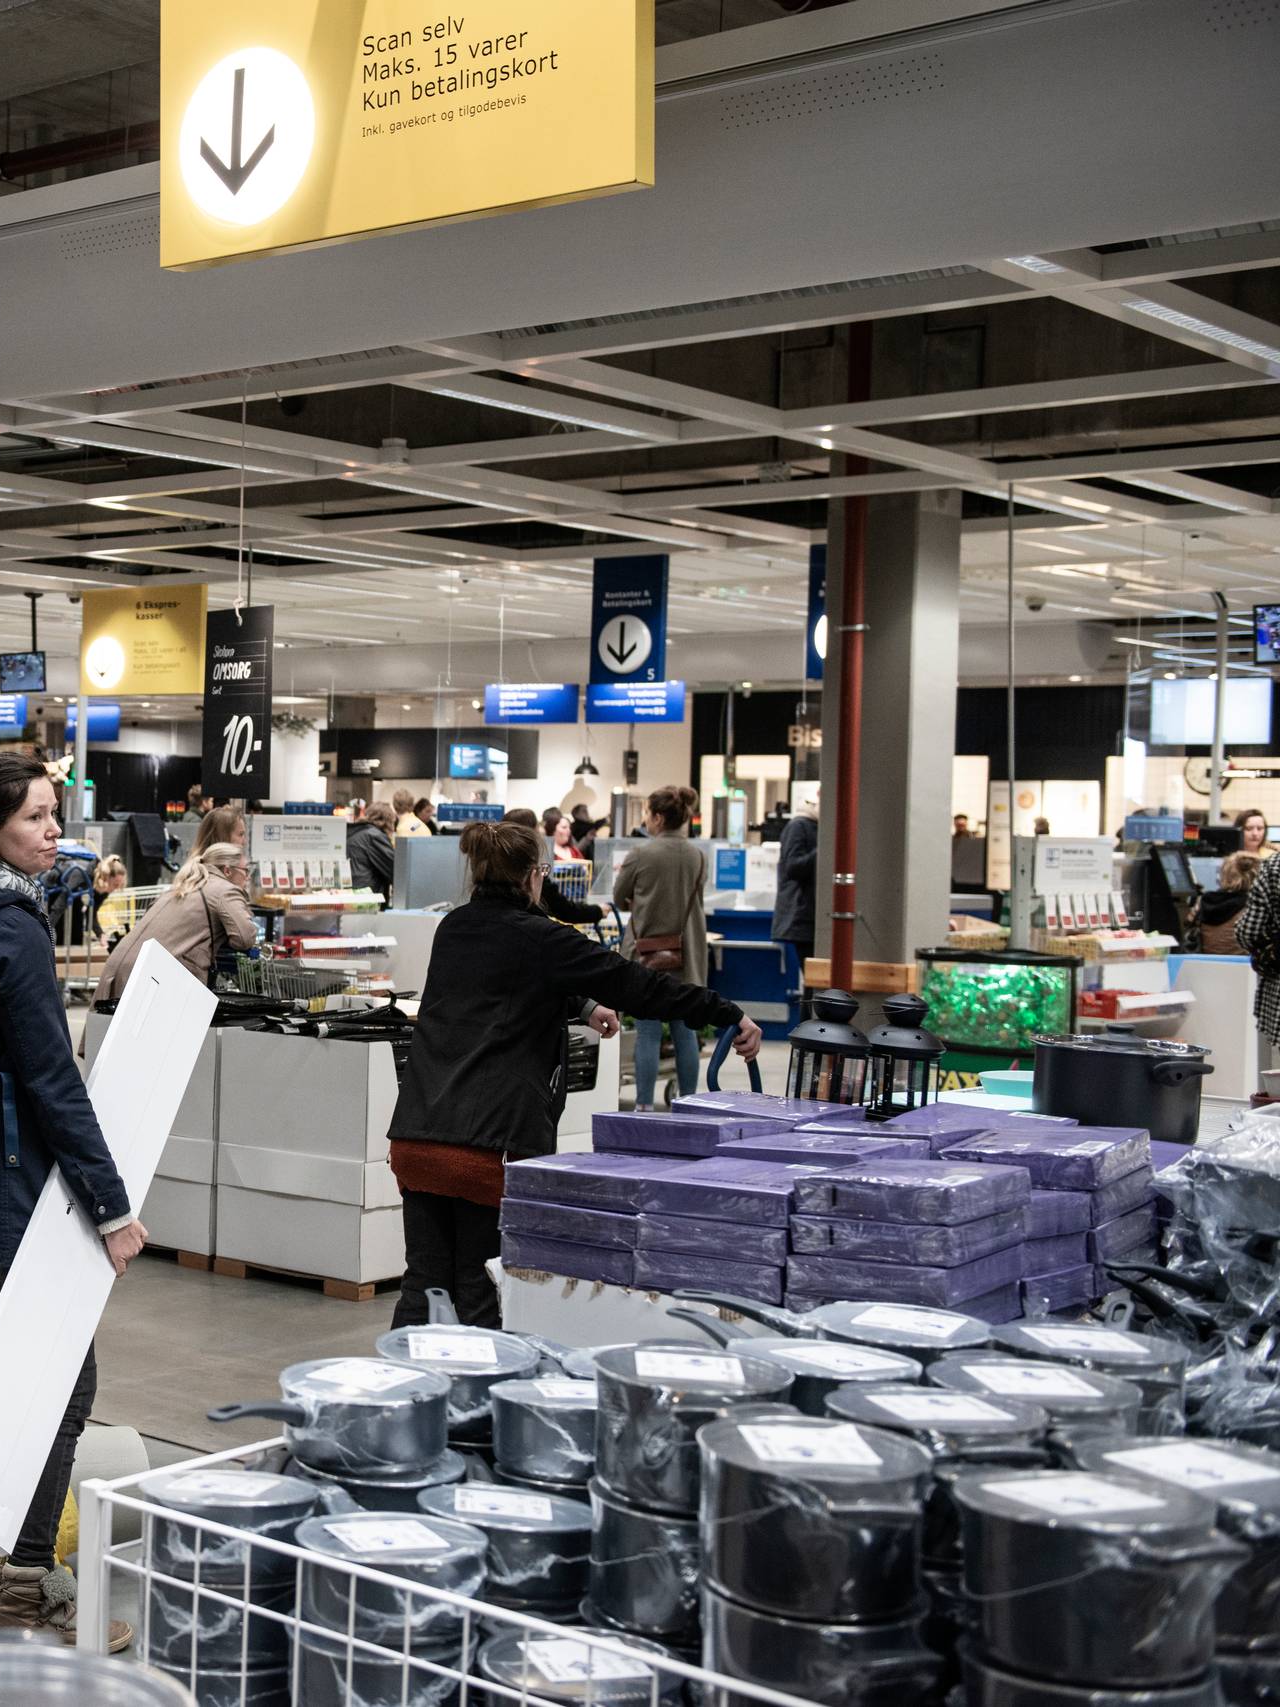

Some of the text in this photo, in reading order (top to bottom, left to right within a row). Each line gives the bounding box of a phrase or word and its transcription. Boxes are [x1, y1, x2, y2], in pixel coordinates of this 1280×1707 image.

[363, 15, 465, 56] Scan selv
[363, 31, 528, 84] Maks. 15 varer
[363, 50, 559, 111] Kun betalingskort
[362, 93, 527, 138] Inkl. gavekort og tilgodebevis
[144, 601, 180, 609] Ekspres-
[602, 599, 652, 608] Betalingskort
[212, 661, 252, 681] OMSORG
[647, 667, 655, 681] 5
